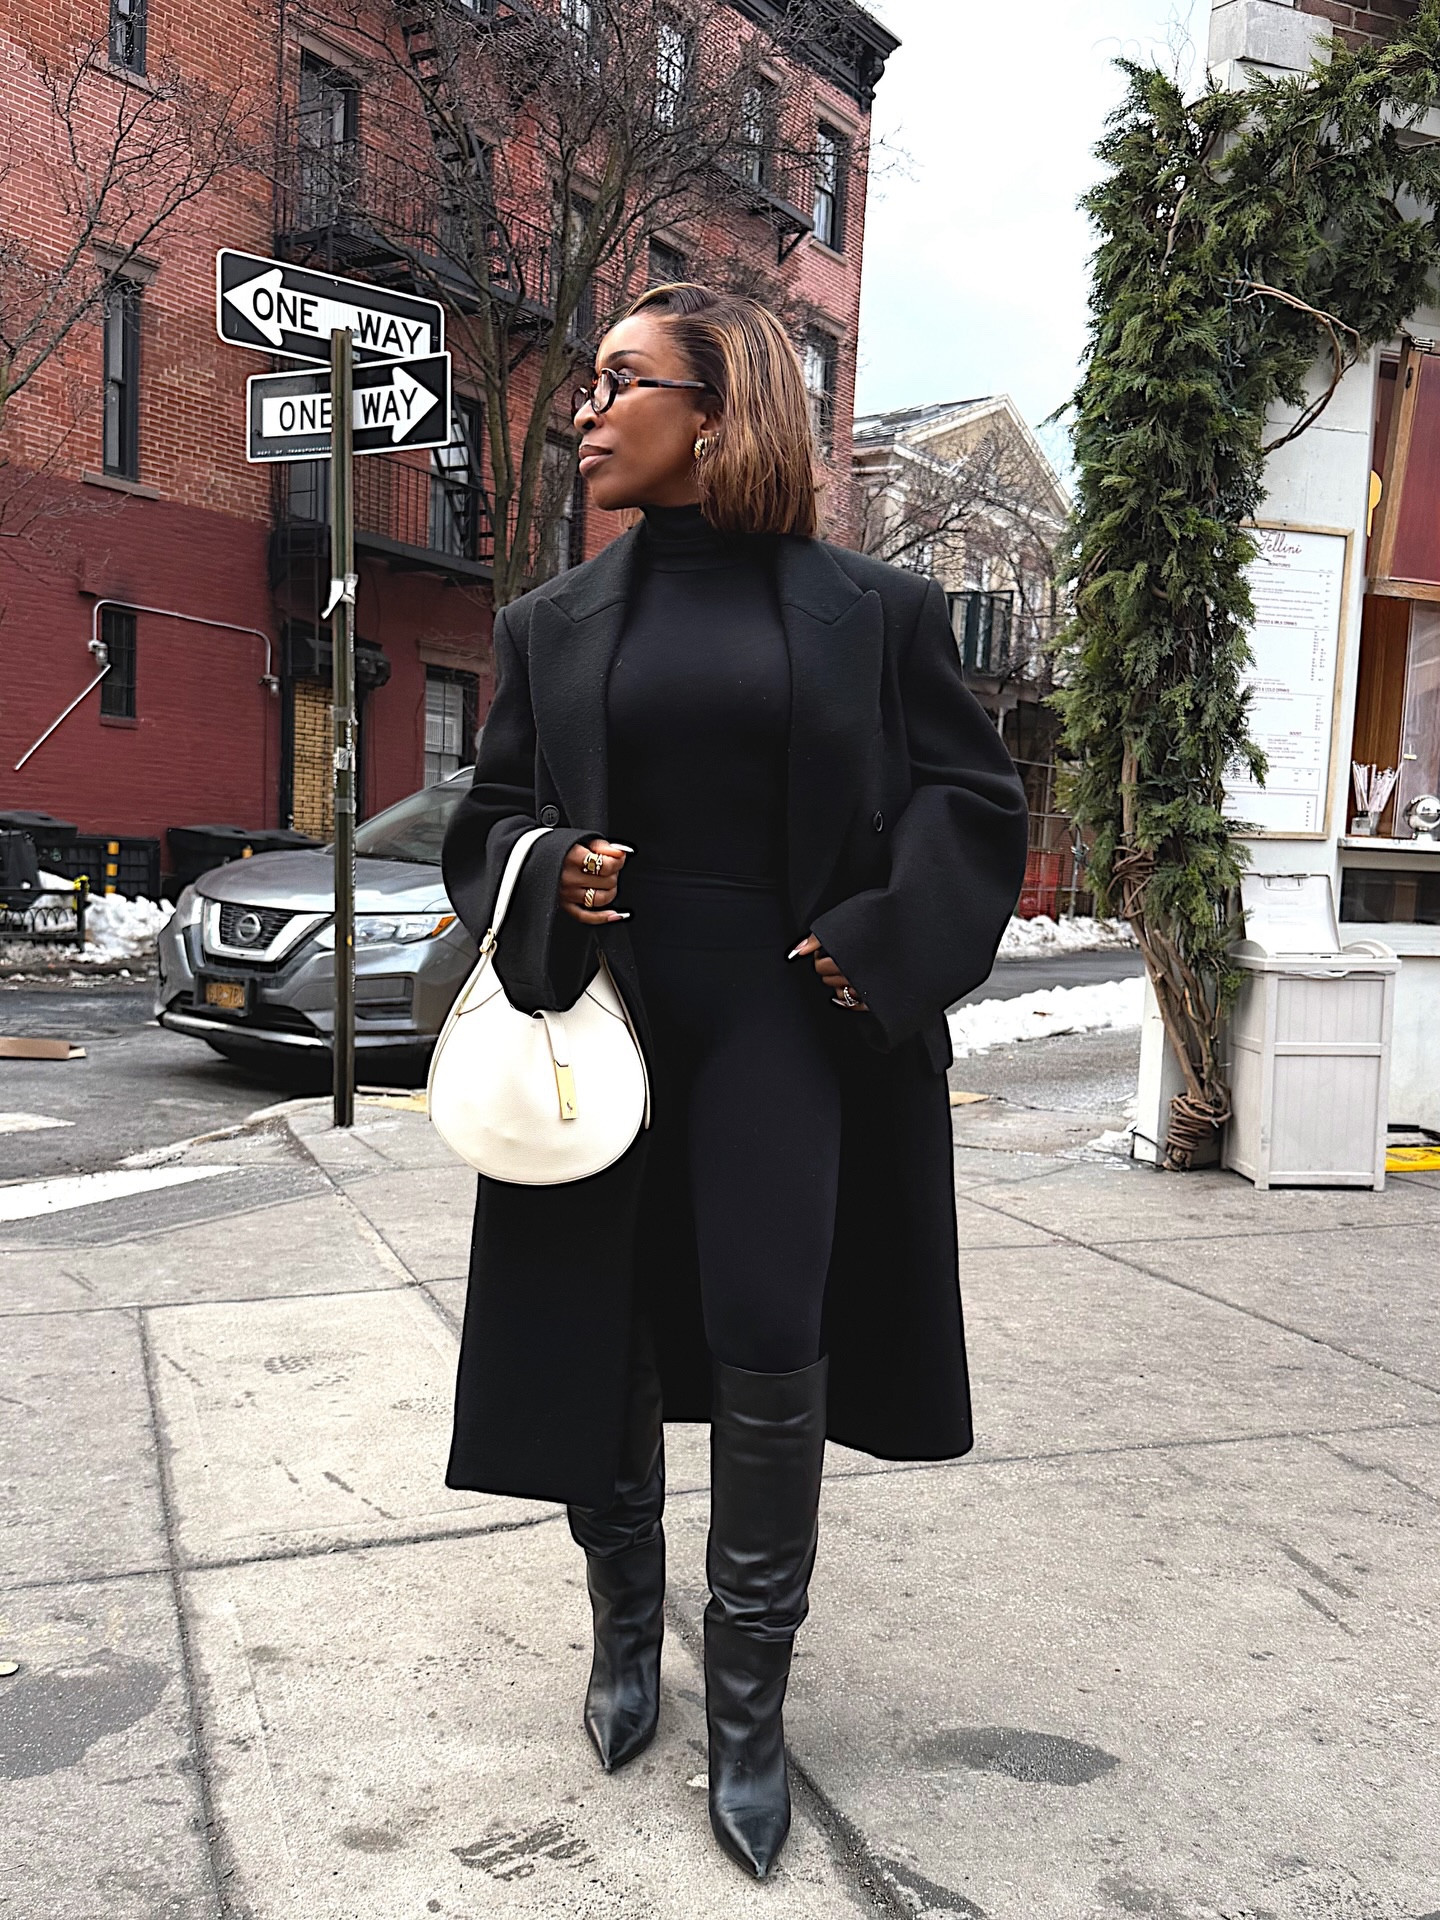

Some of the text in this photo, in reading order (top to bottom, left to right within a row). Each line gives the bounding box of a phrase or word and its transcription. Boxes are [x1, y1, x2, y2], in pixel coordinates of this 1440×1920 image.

[252, 288, 424, 355] ONE WAY
[279, 387, 418, 432] ONE WAY
[1259, 529, 1302, 555] Fellini
